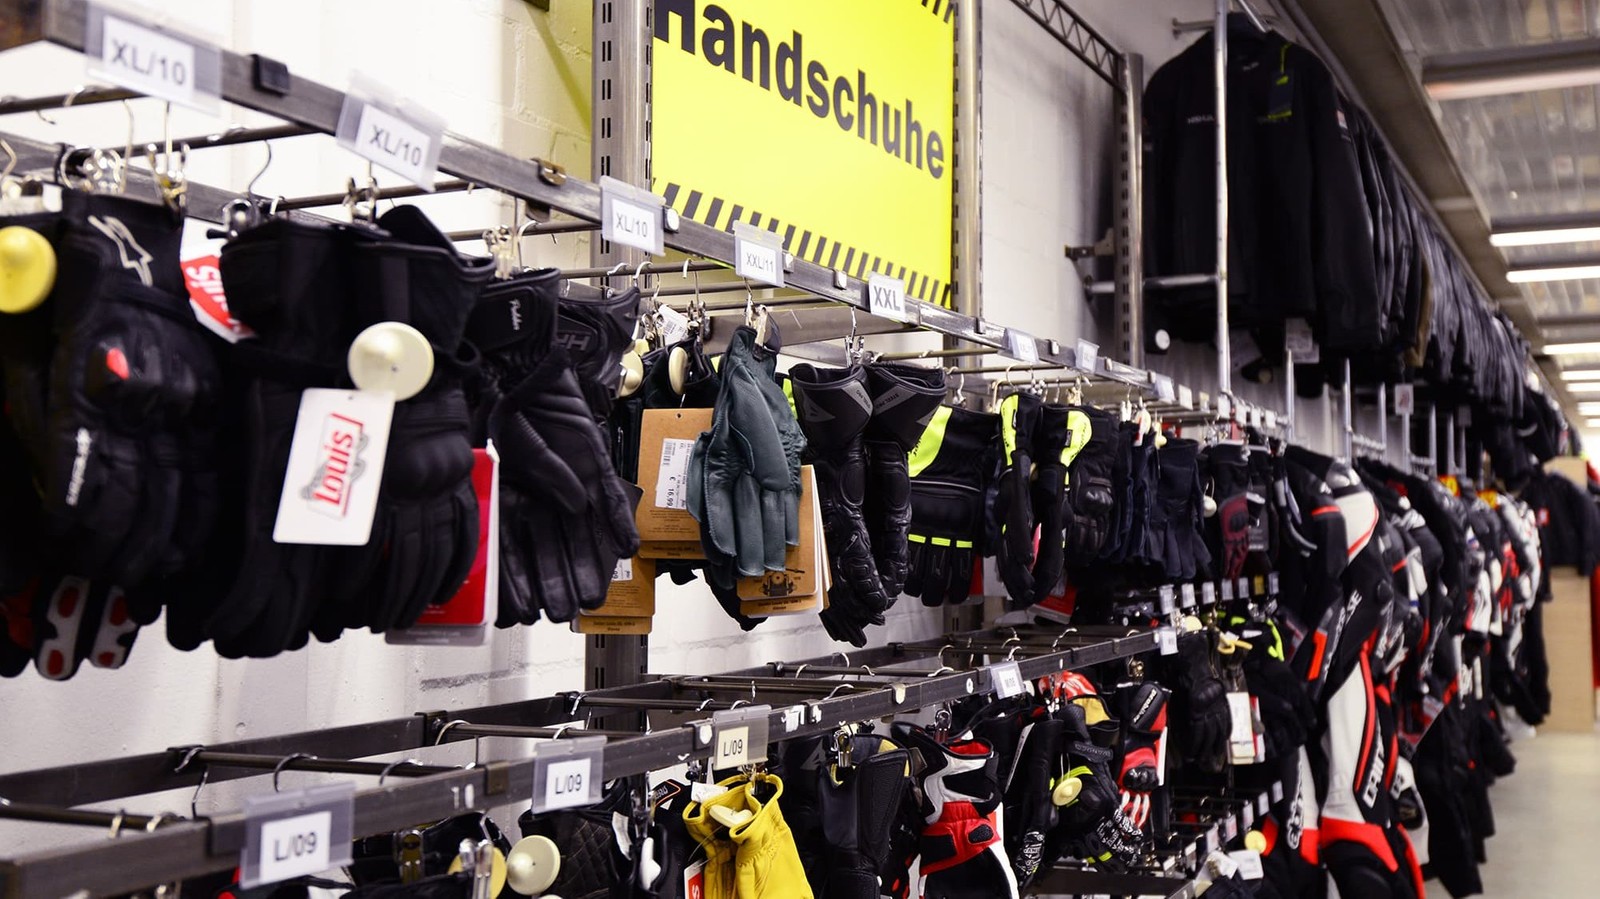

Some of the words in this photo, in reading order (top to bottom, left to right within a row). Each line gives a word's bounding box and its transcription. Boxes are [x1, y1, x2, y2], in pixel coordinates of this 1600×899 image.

[110, 38, 186, 86] XL/10
[654, 0, 944, 179] Handschuhe
[369, 122, 422, 167] XL/10
[615, 215, 649, 240] XL/10
[745, 251, 775, 274] XXL/11
[873, 284, 901, 312] XXL
[312, 430, 354, 507] Louis
[723, 738, 744, 758] L/09
[554, 776, 583, 797] L/09
[273, 830, 318, 863] L/09
